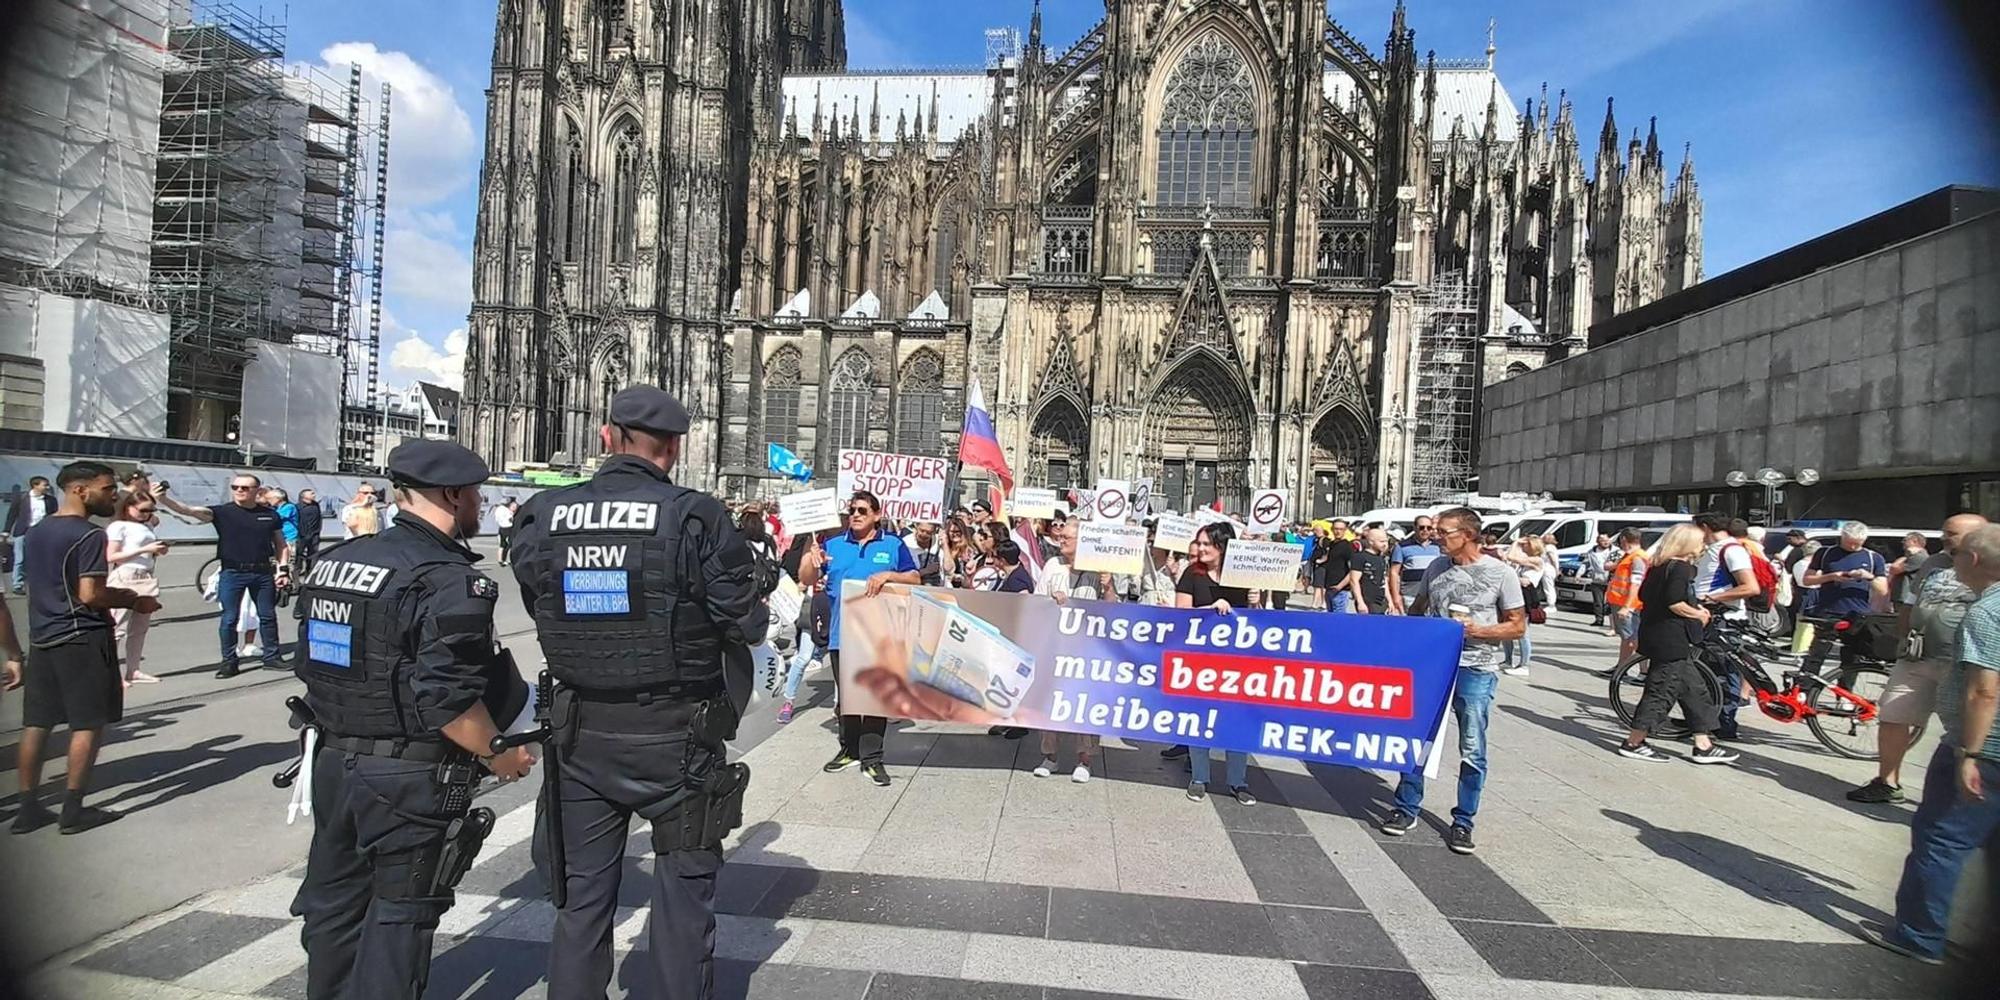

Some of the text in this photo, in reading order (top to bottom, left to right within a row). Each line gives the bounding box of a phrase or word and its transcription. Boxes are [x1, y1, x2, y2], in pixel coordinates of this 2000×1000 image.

[841, 451, 945, 480] SOFORTIGER
[852, 473, 913, 498] STOPP
[549, 501, 658, 531] POLIZEI
[1080, 524, 1145, 537] Frieden schaffen
[1081, 536, 1103, 544] OHNE
[566, 544, 627, 568] NRW
[1094, 545, 1142, 556] WAFFEN!!!
[1233, 554, 1290, 566] KEINE Waffen
[1245, 544, 1270, 552] wollen
[1272, 545, 1303, 555] Frieden
[304, 560, 390, 593] POLIZEI
[571, 572, 627, 590] VERBINDUNGS
[310, 597, 352, 624] NRW
[948, 619, 969, 643] 20
[1058, 606, 1313, 654] Unser Leben
[765, 656, 777, 691] NRW
[1053, 655, 1404, 711] muss bezahlbar
[984, 673, 1021, 710] 20
[1050, 691, 1219, 740] bleiben!
